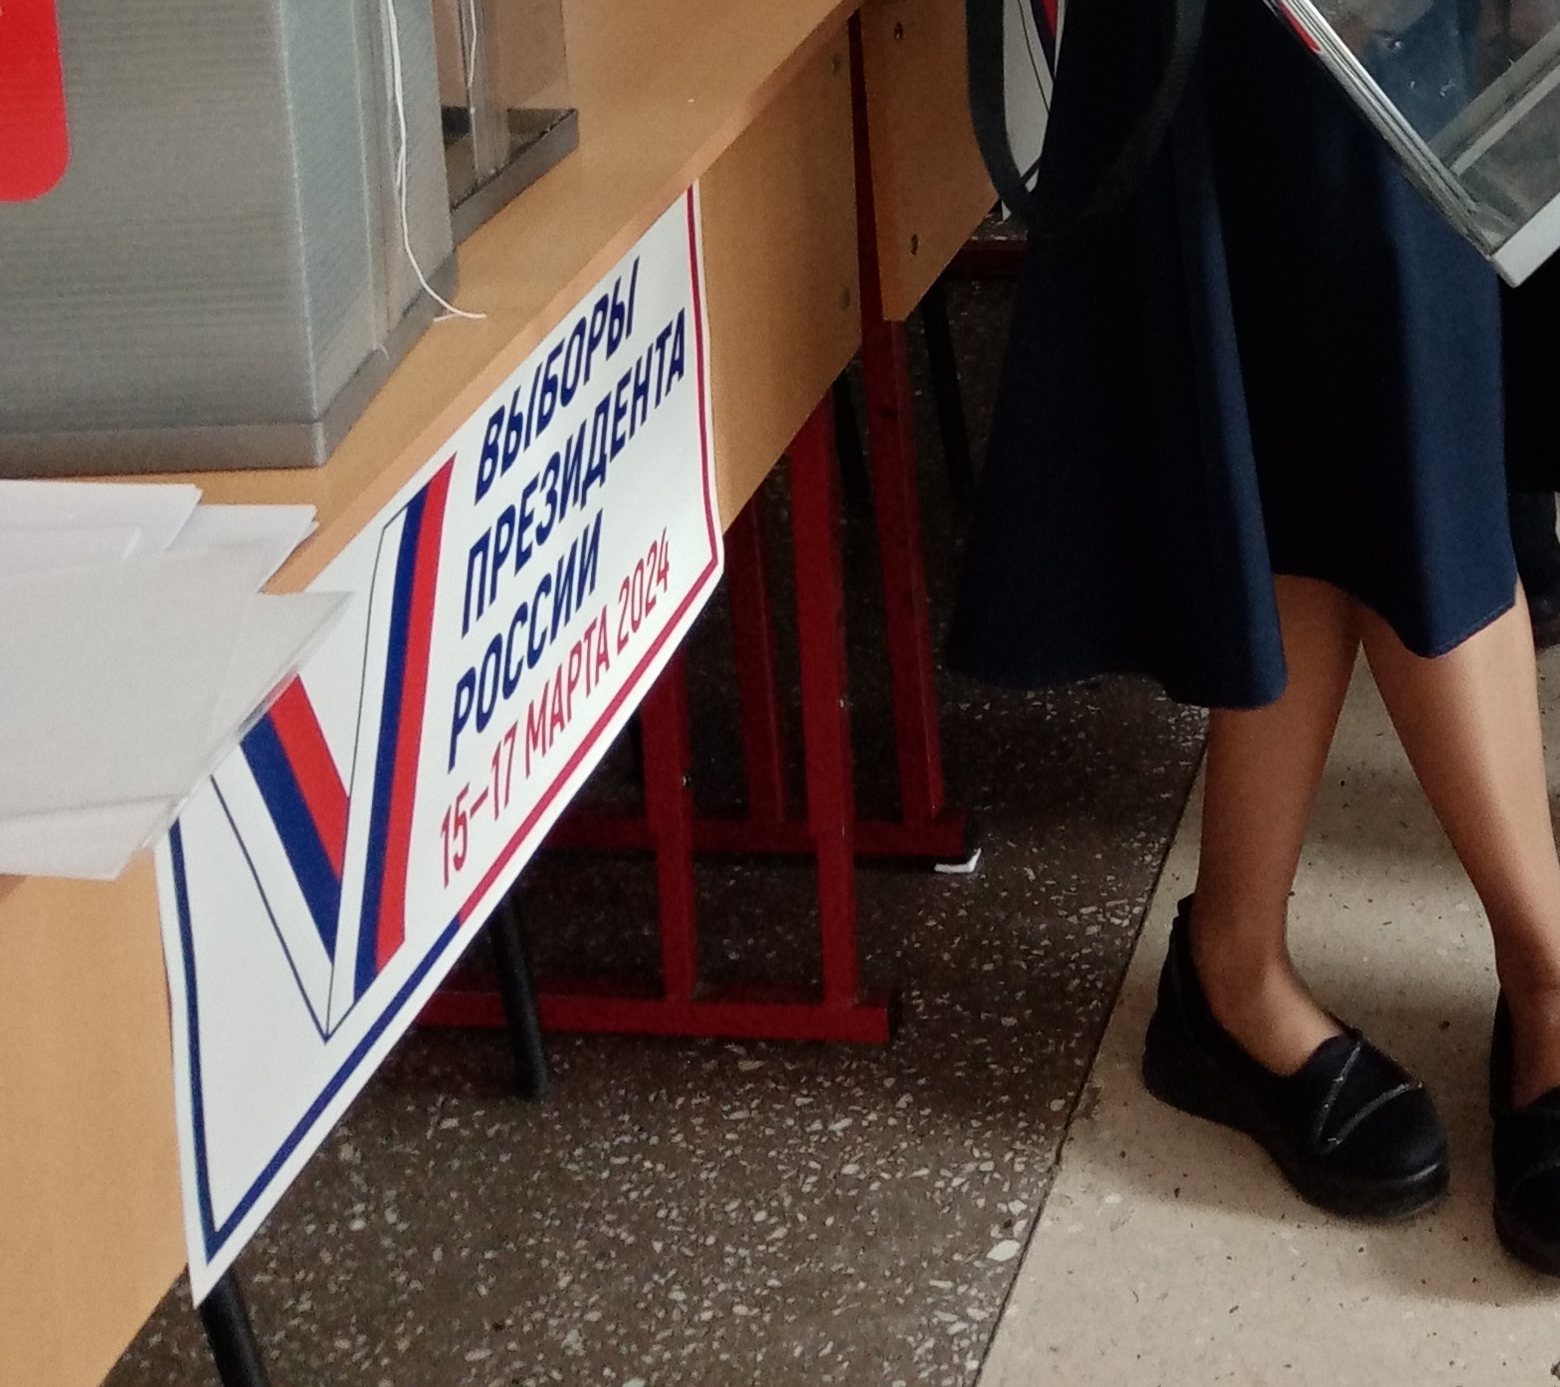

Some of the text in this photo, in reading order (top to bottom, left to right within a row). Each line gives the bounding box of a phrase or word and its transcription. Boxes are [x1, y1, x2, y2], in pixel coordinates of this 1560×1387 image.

[461, 307, 685, 639] ПРЕЗИДЕНТА
[474, 255, 640, 507] ВЫБОРЫ
[447, 508, 603, 774] РОССИИ
[525, 603, 611, 779] МАРТА
[616, 527, 670, 656] 2024
